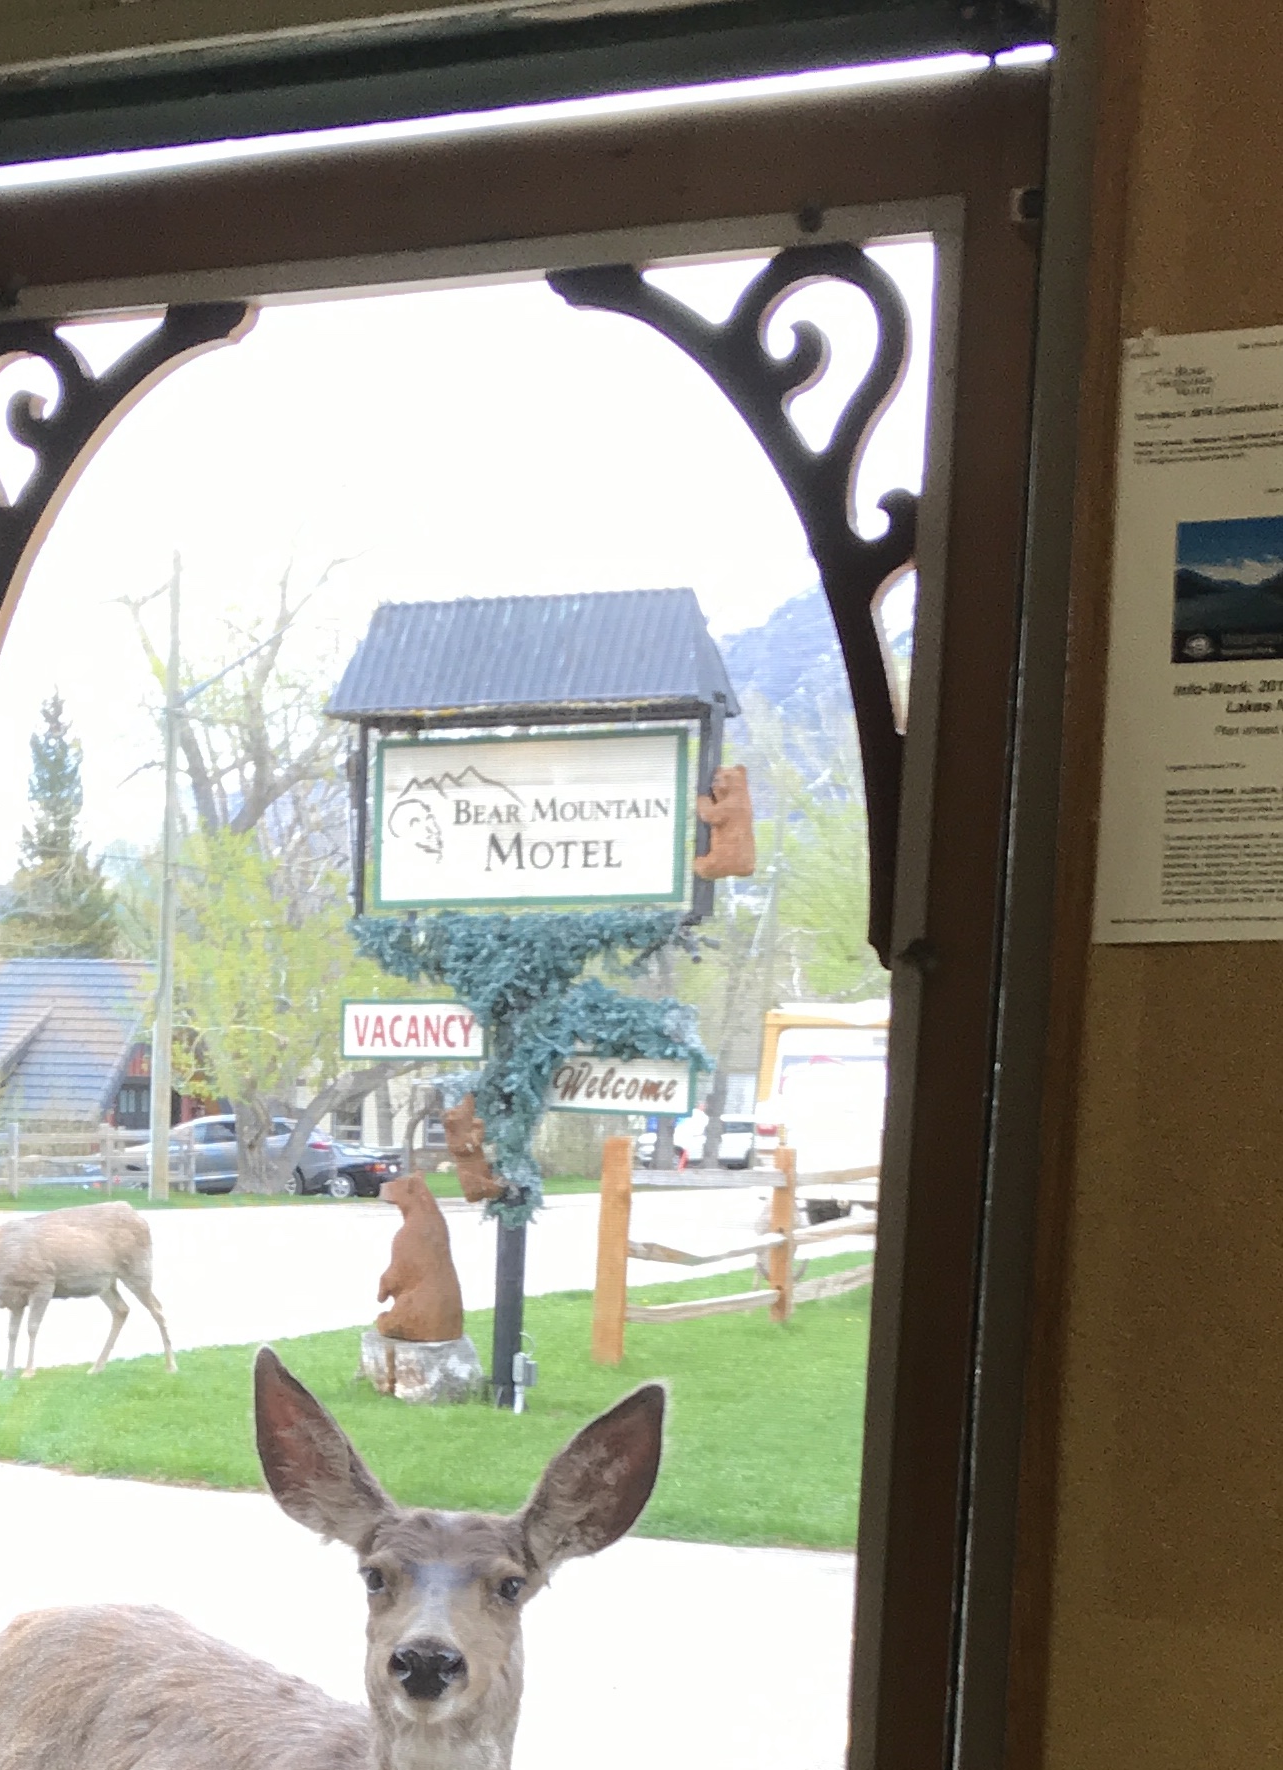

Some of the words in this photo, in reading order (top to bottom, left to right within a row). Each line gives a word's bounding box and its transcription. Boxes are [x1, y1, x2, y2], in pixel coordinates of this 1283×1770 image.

[452, 798, 520, 826] BEAR
[530, 796, 671, 823] MOUNTAIN
[484, 832, 622, 872] MOTEL
[353, 1013, 475, 1048] VACANCY
[553, 1060, 677, 1103] Welcome
